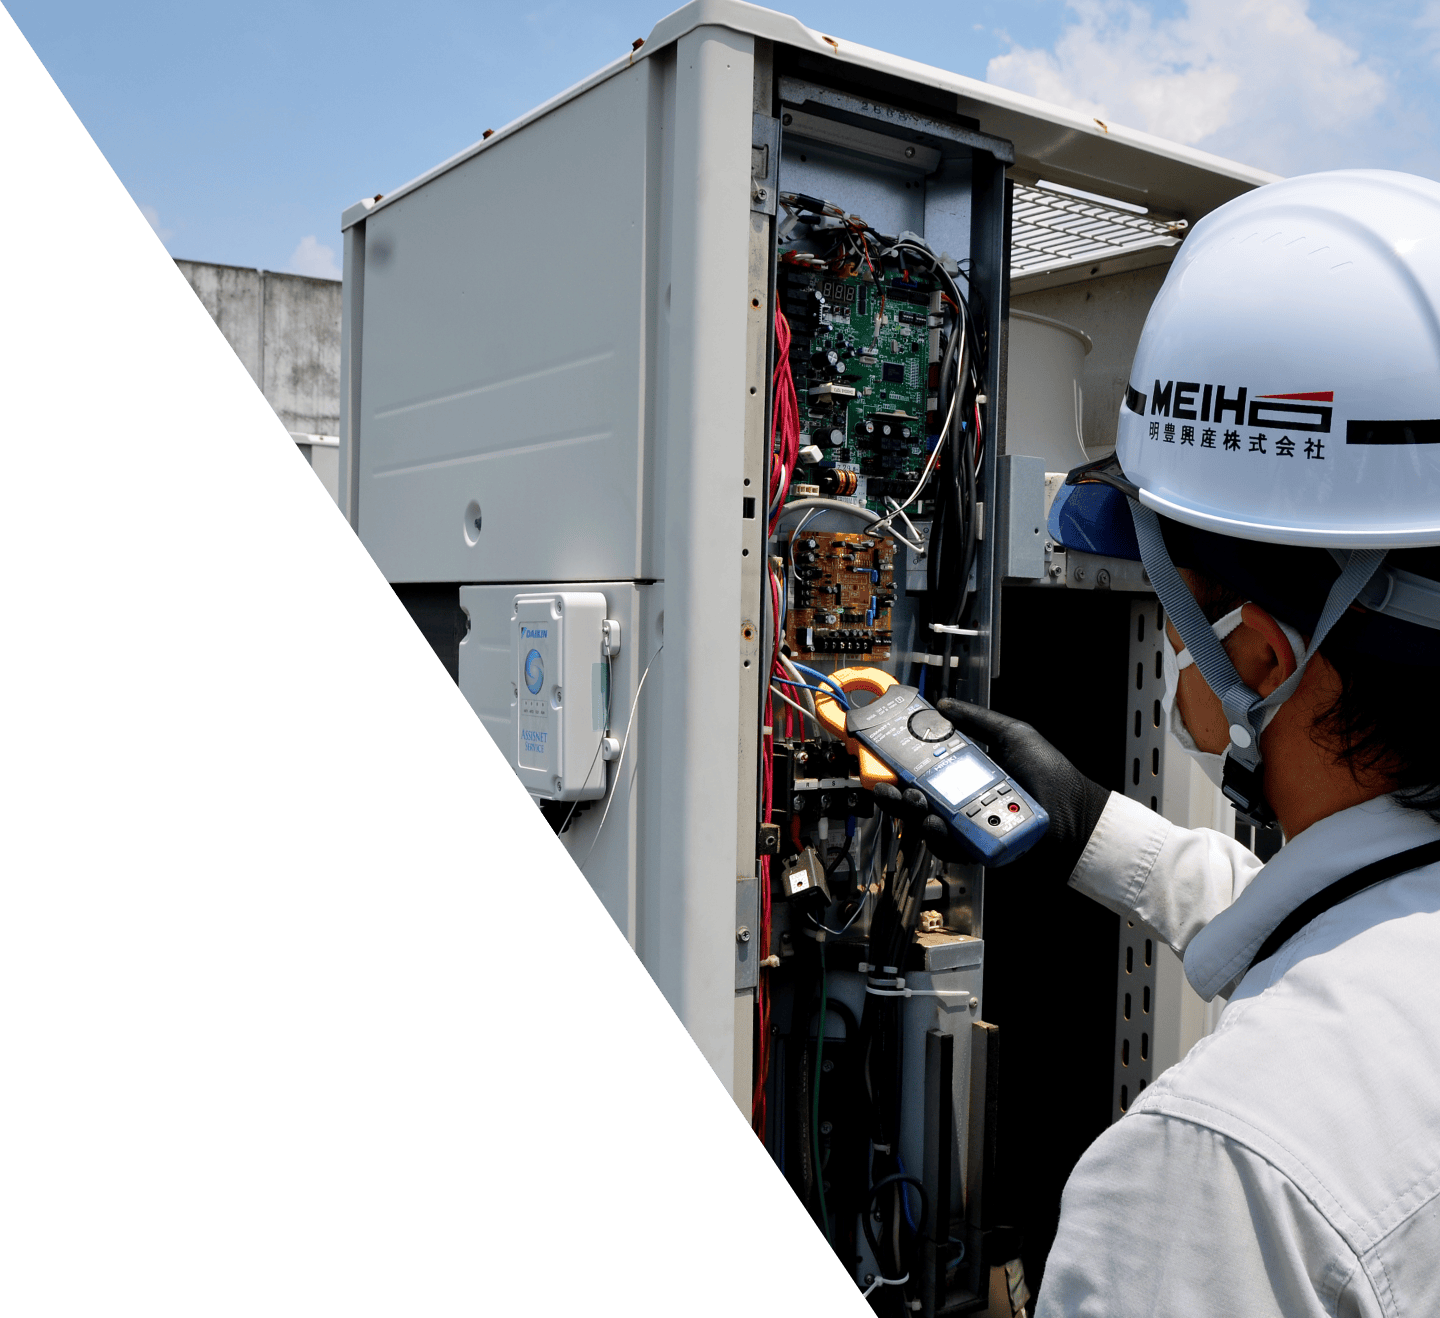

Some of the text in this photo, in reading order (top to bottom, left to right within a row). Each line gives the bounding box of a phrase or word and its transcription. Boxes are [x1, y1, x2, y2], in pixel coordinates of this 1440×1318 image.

[1148, 421, 1326, 460] 明豊興産株式会社
[526, 629, 548, 639] DAIKIN
[520, 728, 548, 743] ASSISNET
[524, 741, 544, 754] SERVICE
[934, 755, 957, 771] HIOKI
